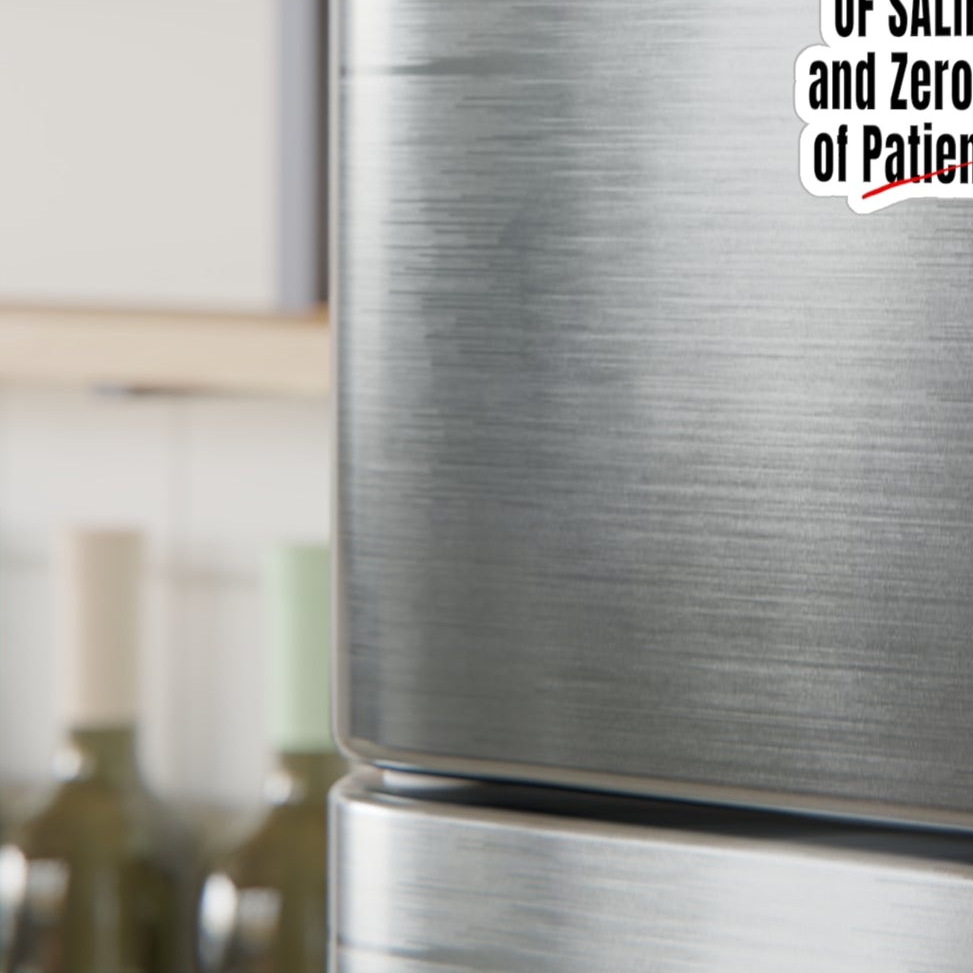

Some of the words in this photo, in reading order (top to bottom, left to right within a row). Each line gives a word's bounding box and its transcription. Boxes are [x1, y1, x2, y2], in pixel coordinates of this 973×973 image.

[808, 51, 876, 111] and
[890, 52, 973, 111] Zero
[813, 124, 848, 183] of
